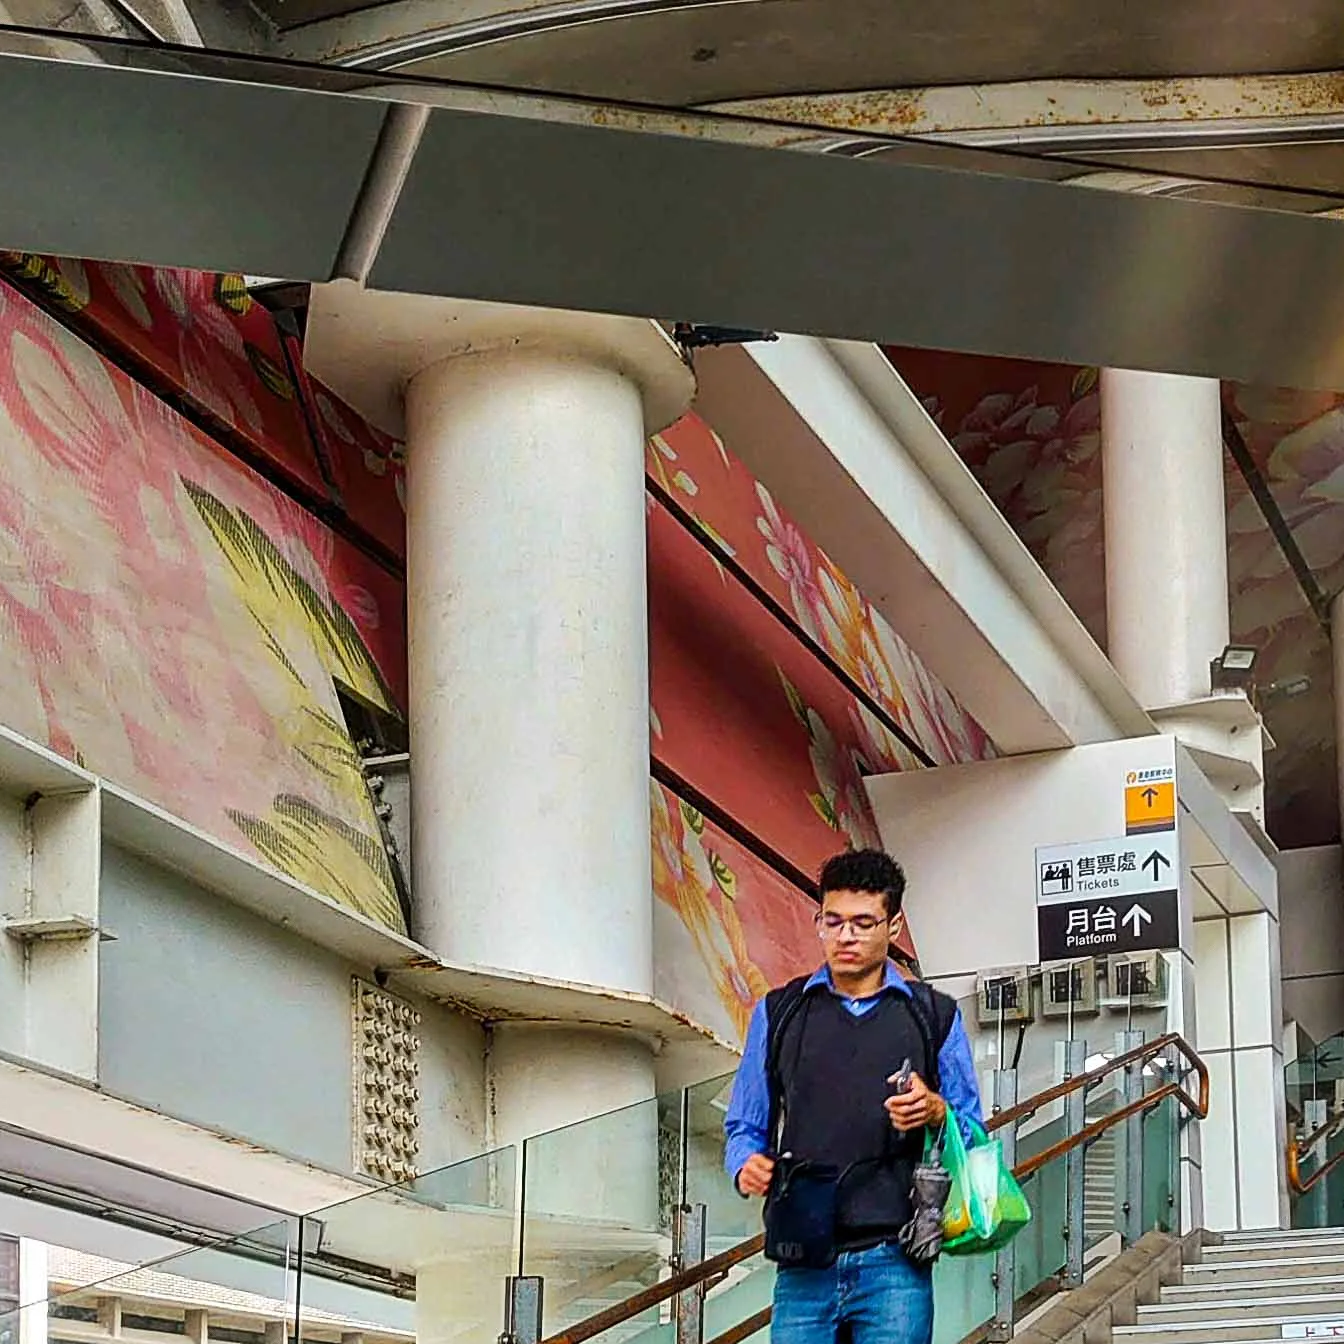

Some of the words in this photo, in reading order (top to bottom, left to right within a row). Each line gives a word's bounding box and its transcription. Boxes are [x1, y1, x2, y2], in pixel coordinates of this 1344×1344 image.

[1076, 852, 1137, 877] 售票處
[1077, 878, 1120, 892] Tickets
[1066, 905, 1117, 935] 月台
[1066, 933, 1117, 947] Platform
